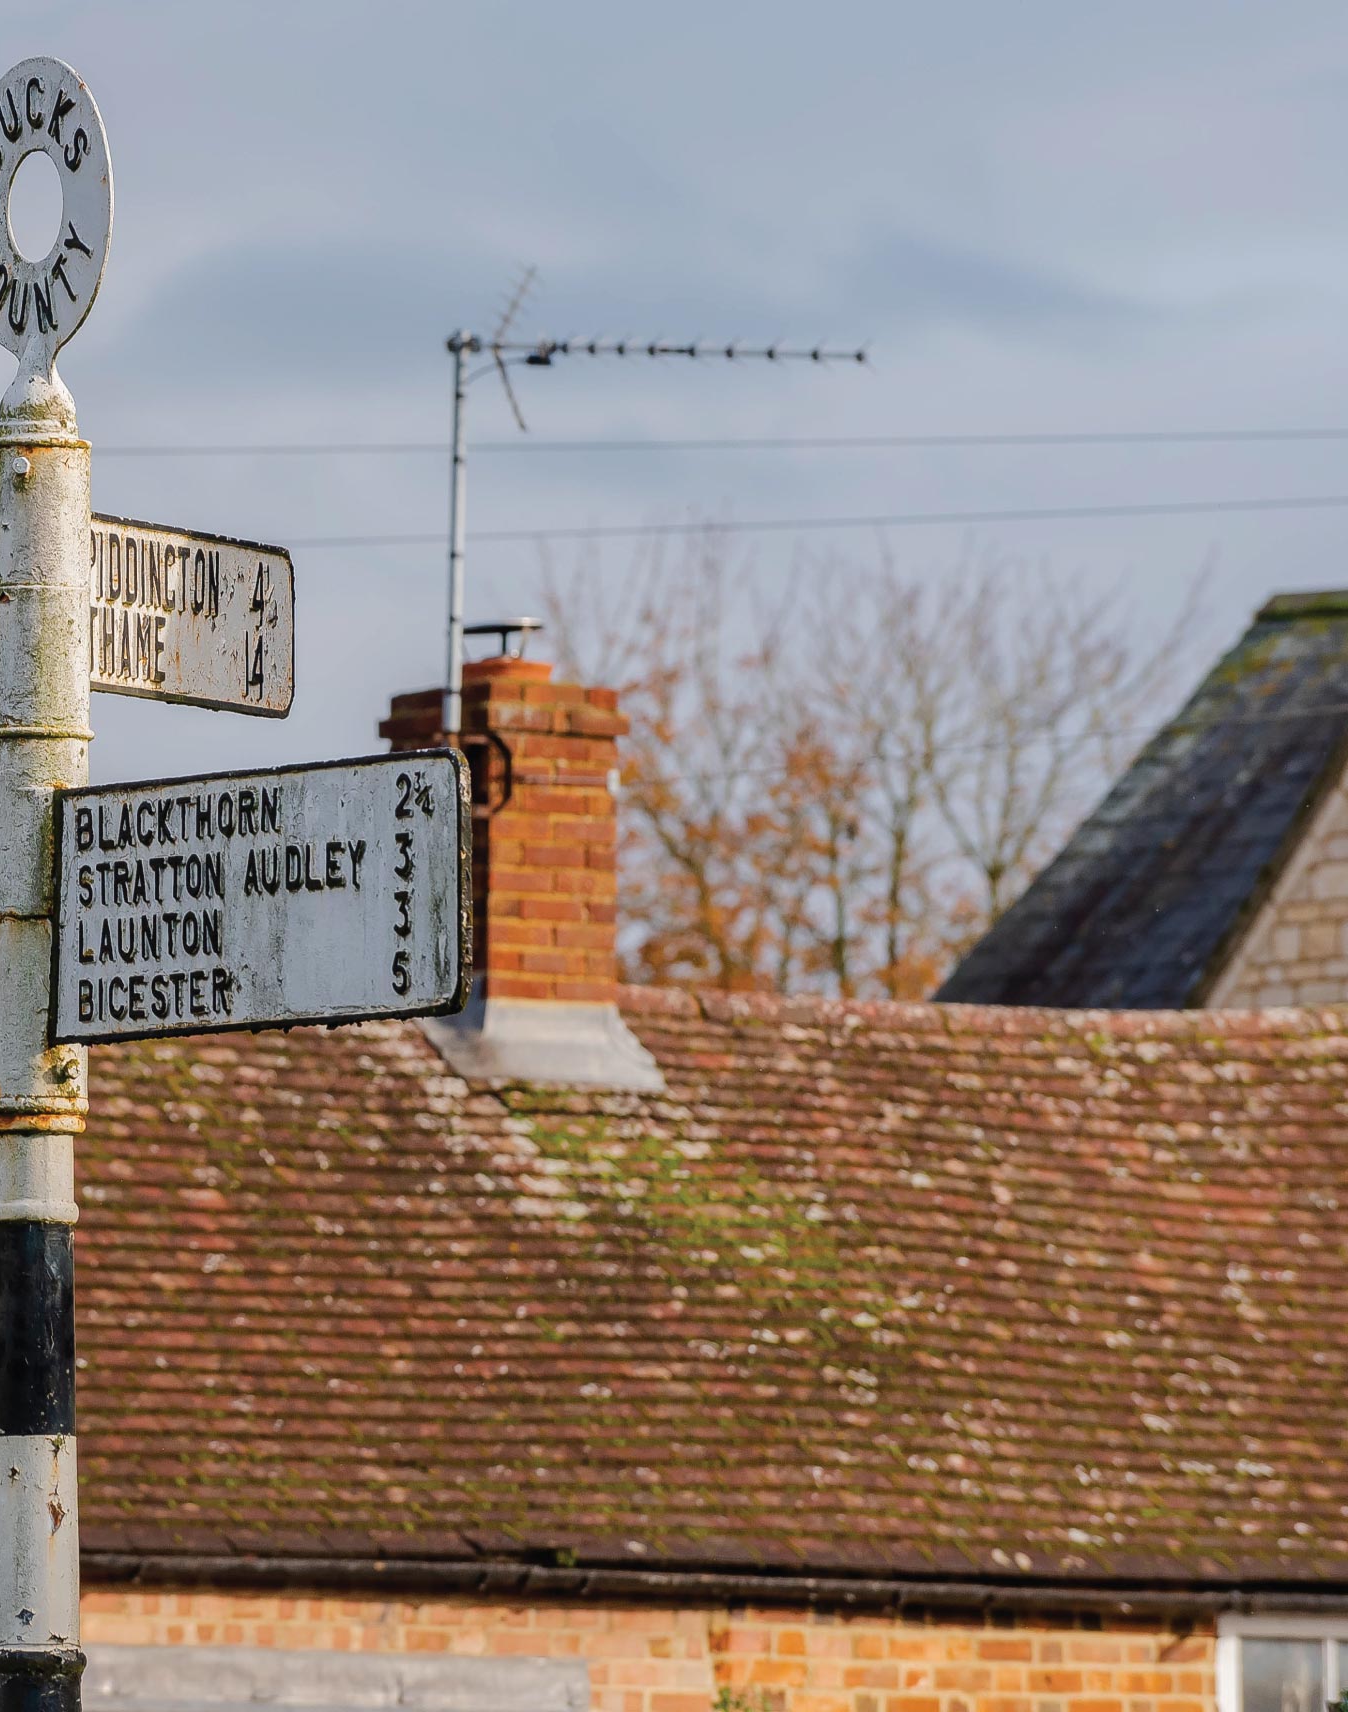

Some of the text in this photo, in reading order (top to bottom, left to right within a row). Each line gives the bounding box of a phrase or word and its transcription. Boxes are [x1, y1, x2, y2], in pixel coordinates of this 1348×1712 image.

[242, 630, 264, 701] 14
[76, 786, 282, 851] BLACKTHORN
[78, 832, 415, 907] STRATTON AUDLEY 3
[78, 891, 413, 965] LAUNTON 3
[78, 951, 412, 1022] BICESTER 5
